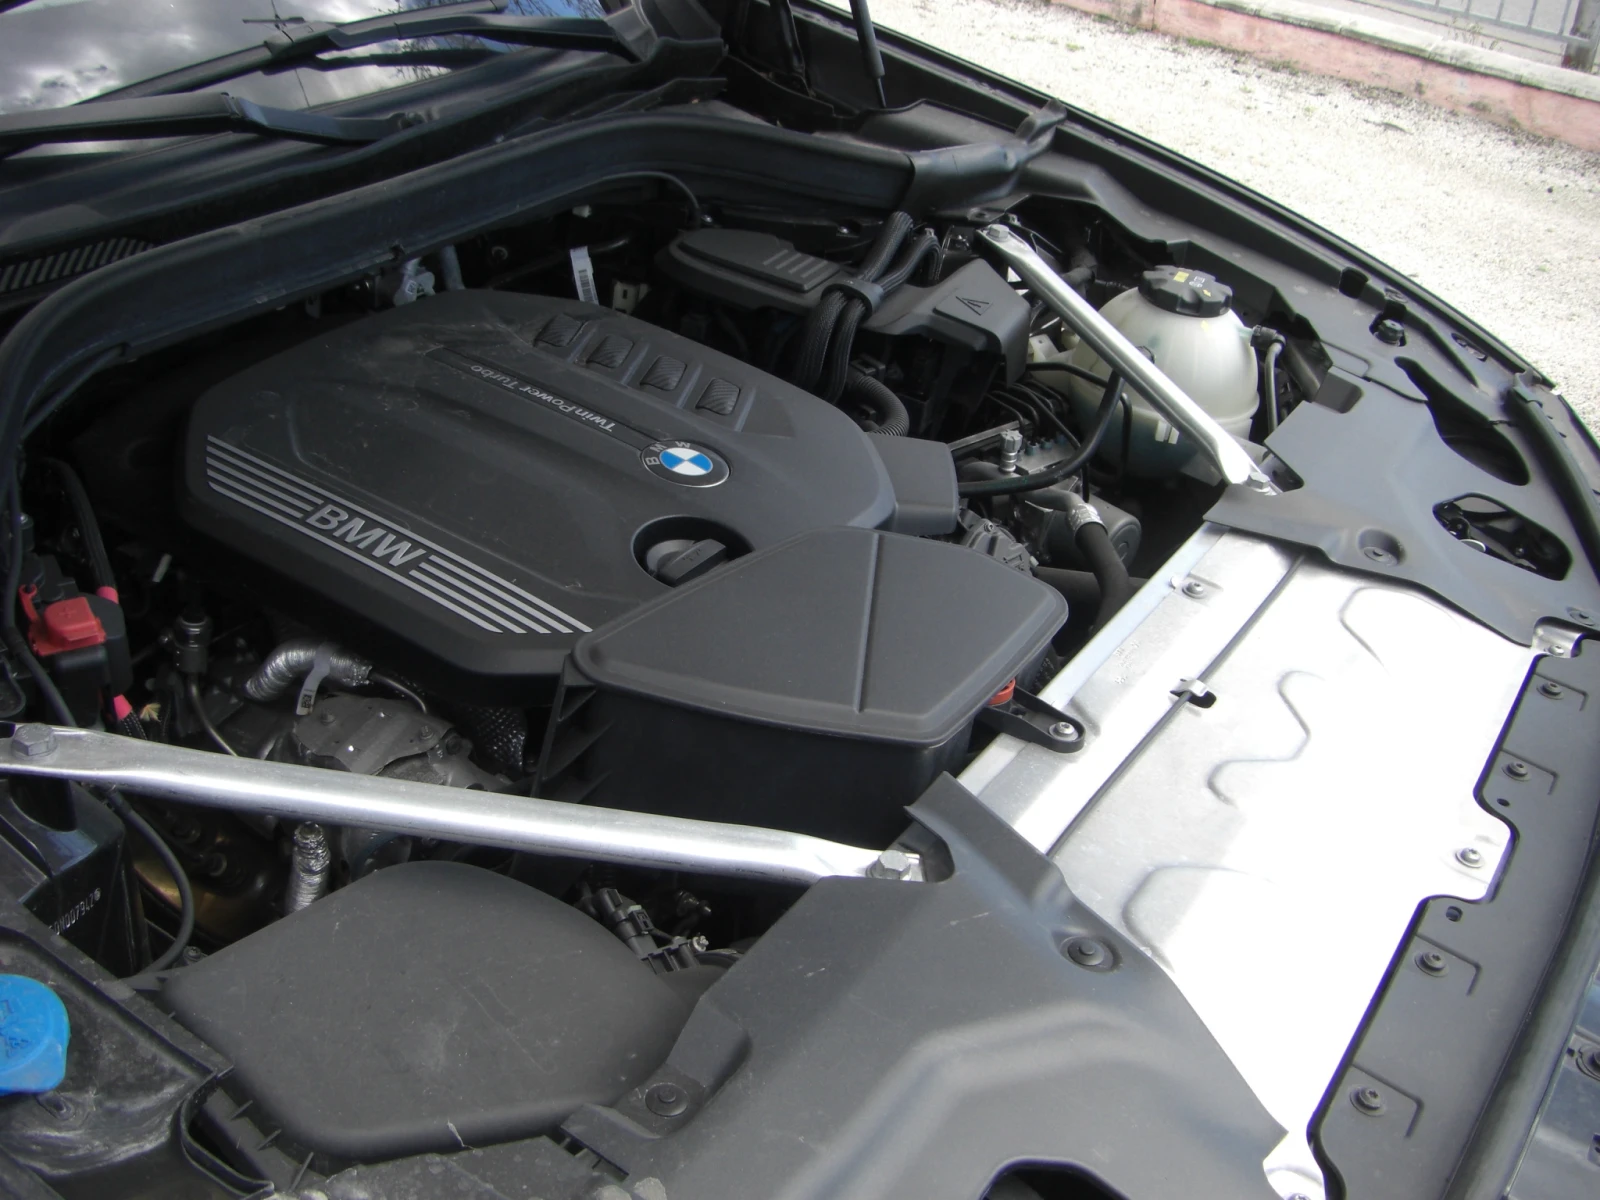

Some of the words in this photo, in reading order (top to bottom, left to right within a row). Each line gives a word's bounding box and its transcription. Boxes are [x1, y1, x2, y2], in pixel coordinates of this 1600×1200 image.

[470, 365, 518, 389] Turbo
[519, 385, 616, 432] TwinPower
[645, 440, 691, 466] BMW
[305, 504, 427, 567] BMW
